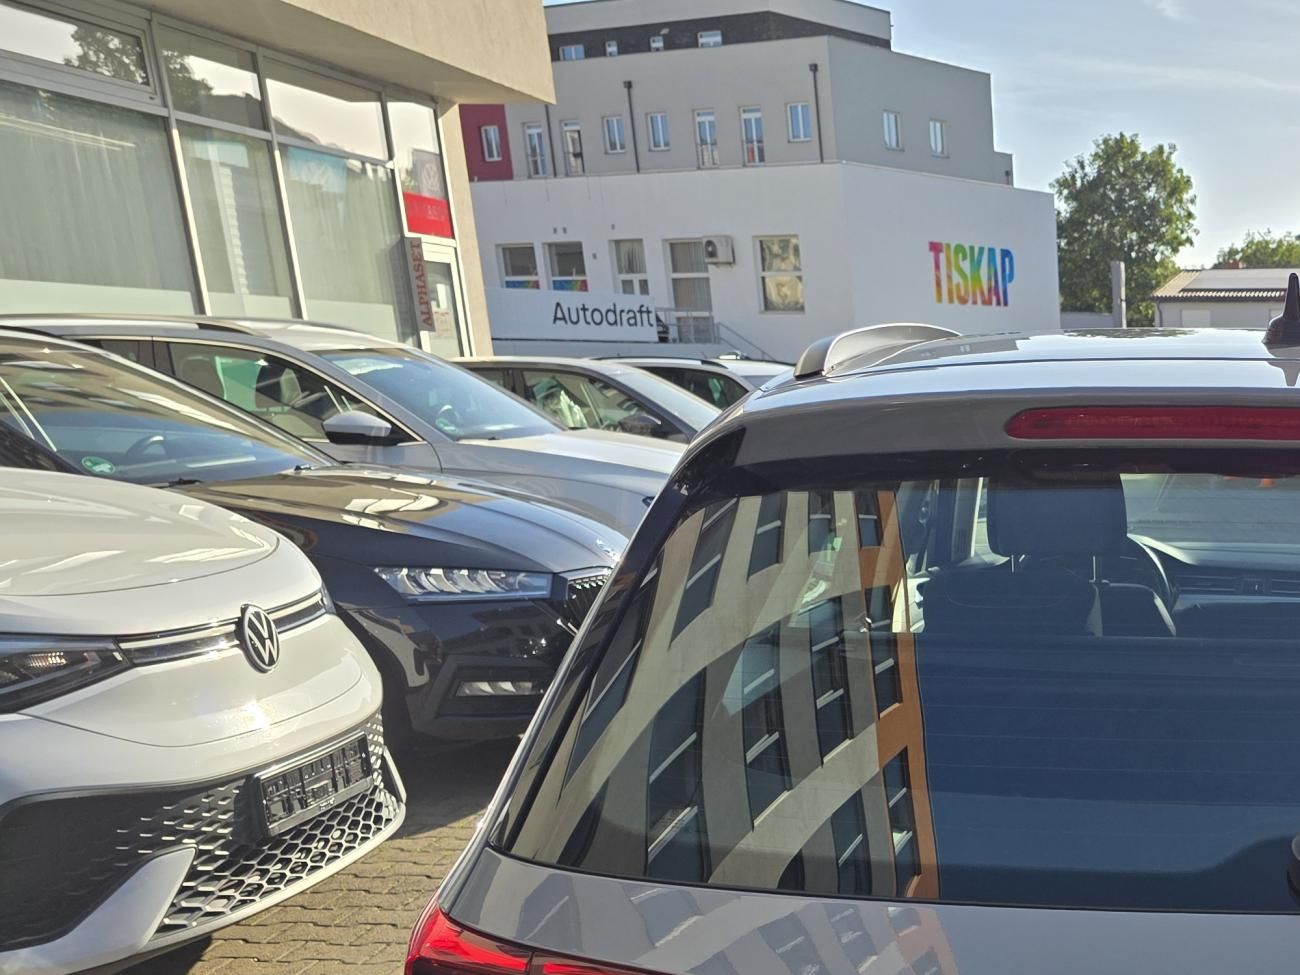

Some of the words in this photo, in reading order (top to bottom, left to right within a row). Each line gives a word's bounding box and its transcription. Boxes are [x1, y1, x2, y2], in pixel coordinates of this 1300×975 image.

[409, 239, 434, 328] ALPHASET
[928, 241, 1014, 306] TISKAP
[553, 302, 654, 327] Autodraft
